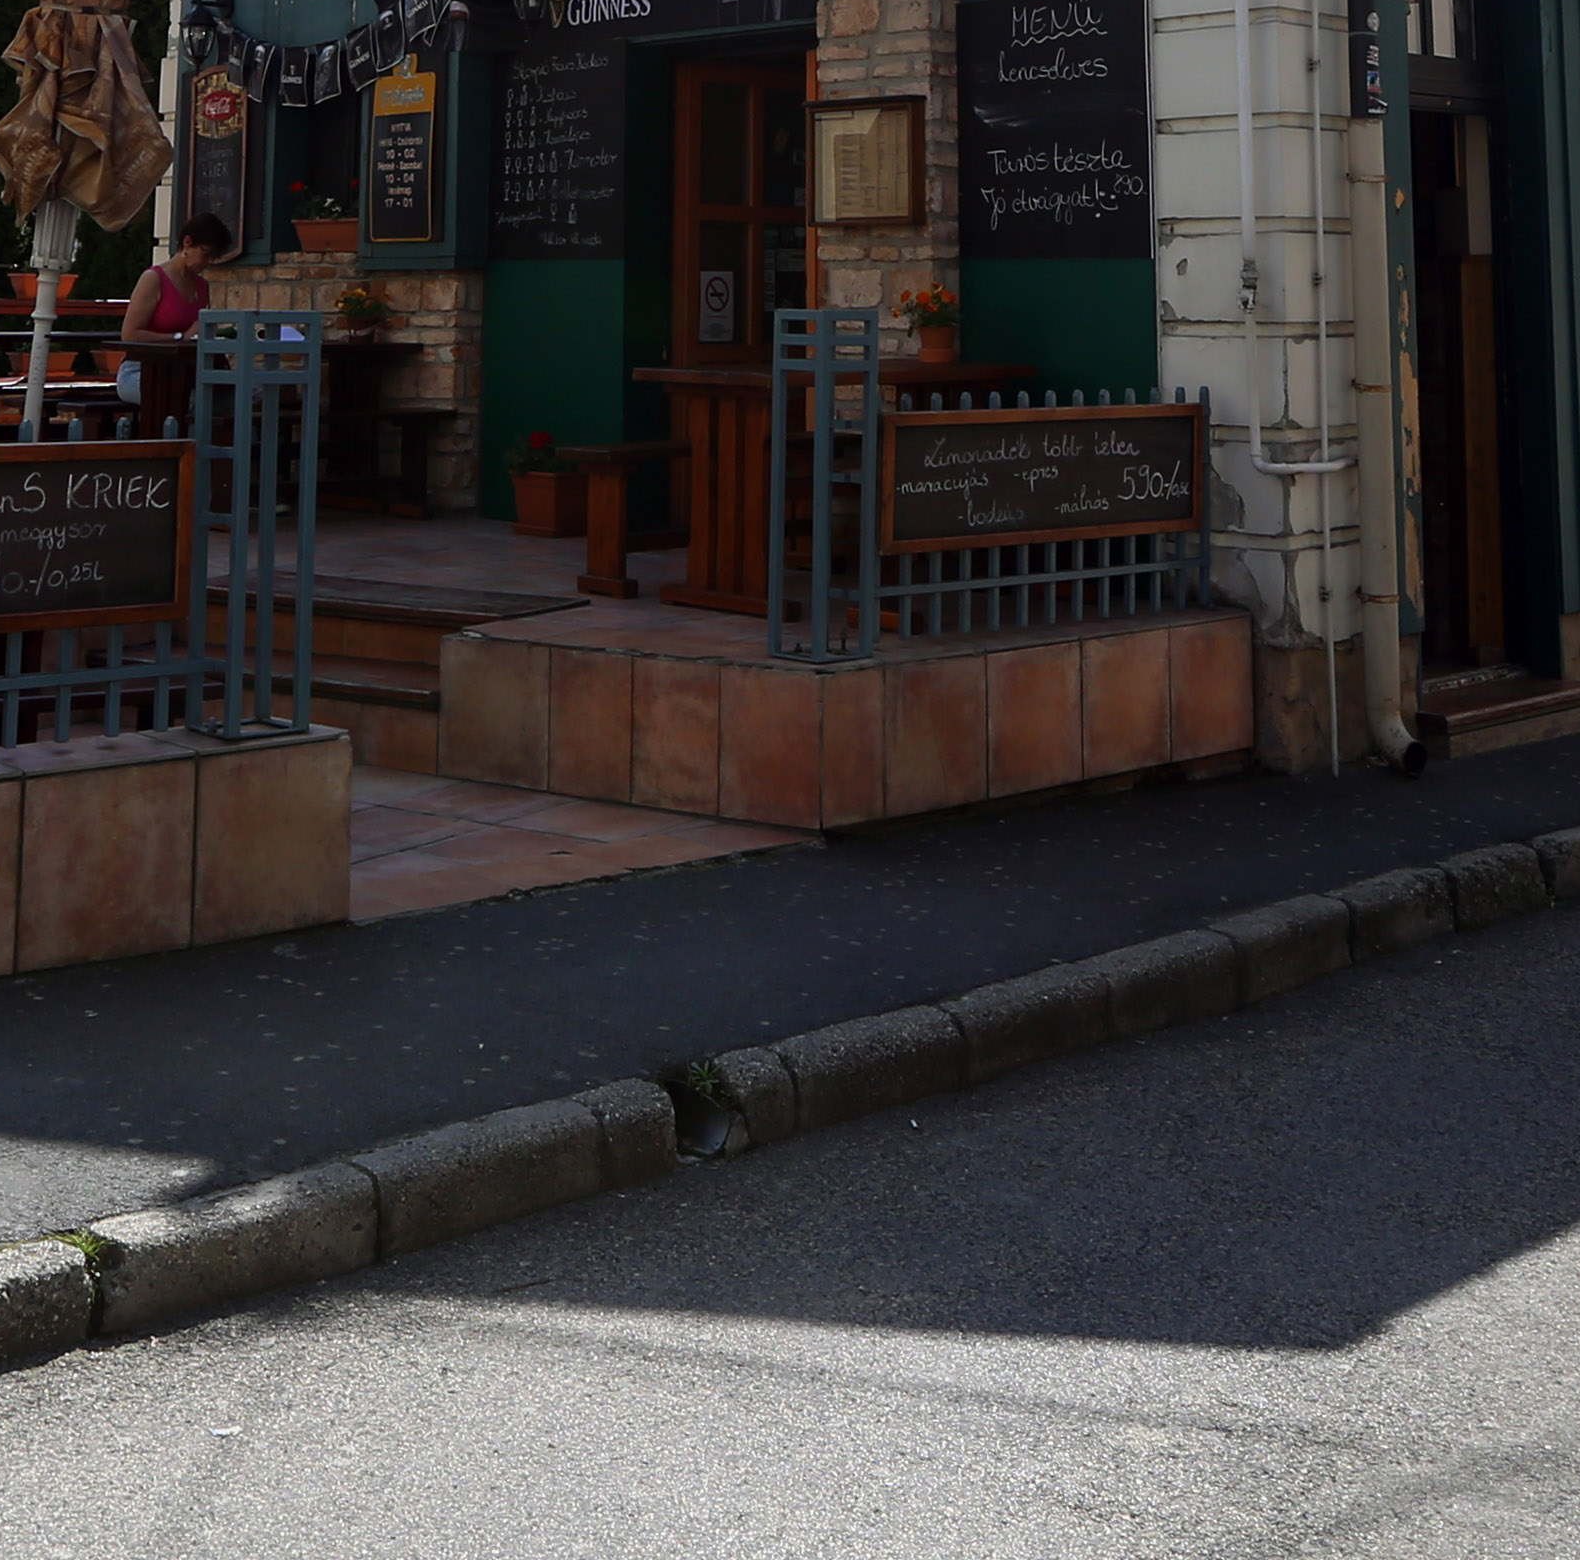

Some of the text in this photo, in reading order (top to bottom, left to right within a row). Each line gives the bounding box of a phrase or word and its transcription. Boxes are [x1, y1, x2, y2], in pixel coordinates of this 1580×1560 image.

[1054, 139, 1132, 174] tészta
[980, 187, 1007, 231] Jó
[1043, 432, 1083, 458] több
[66, 473, 171, 509] KRIEK
